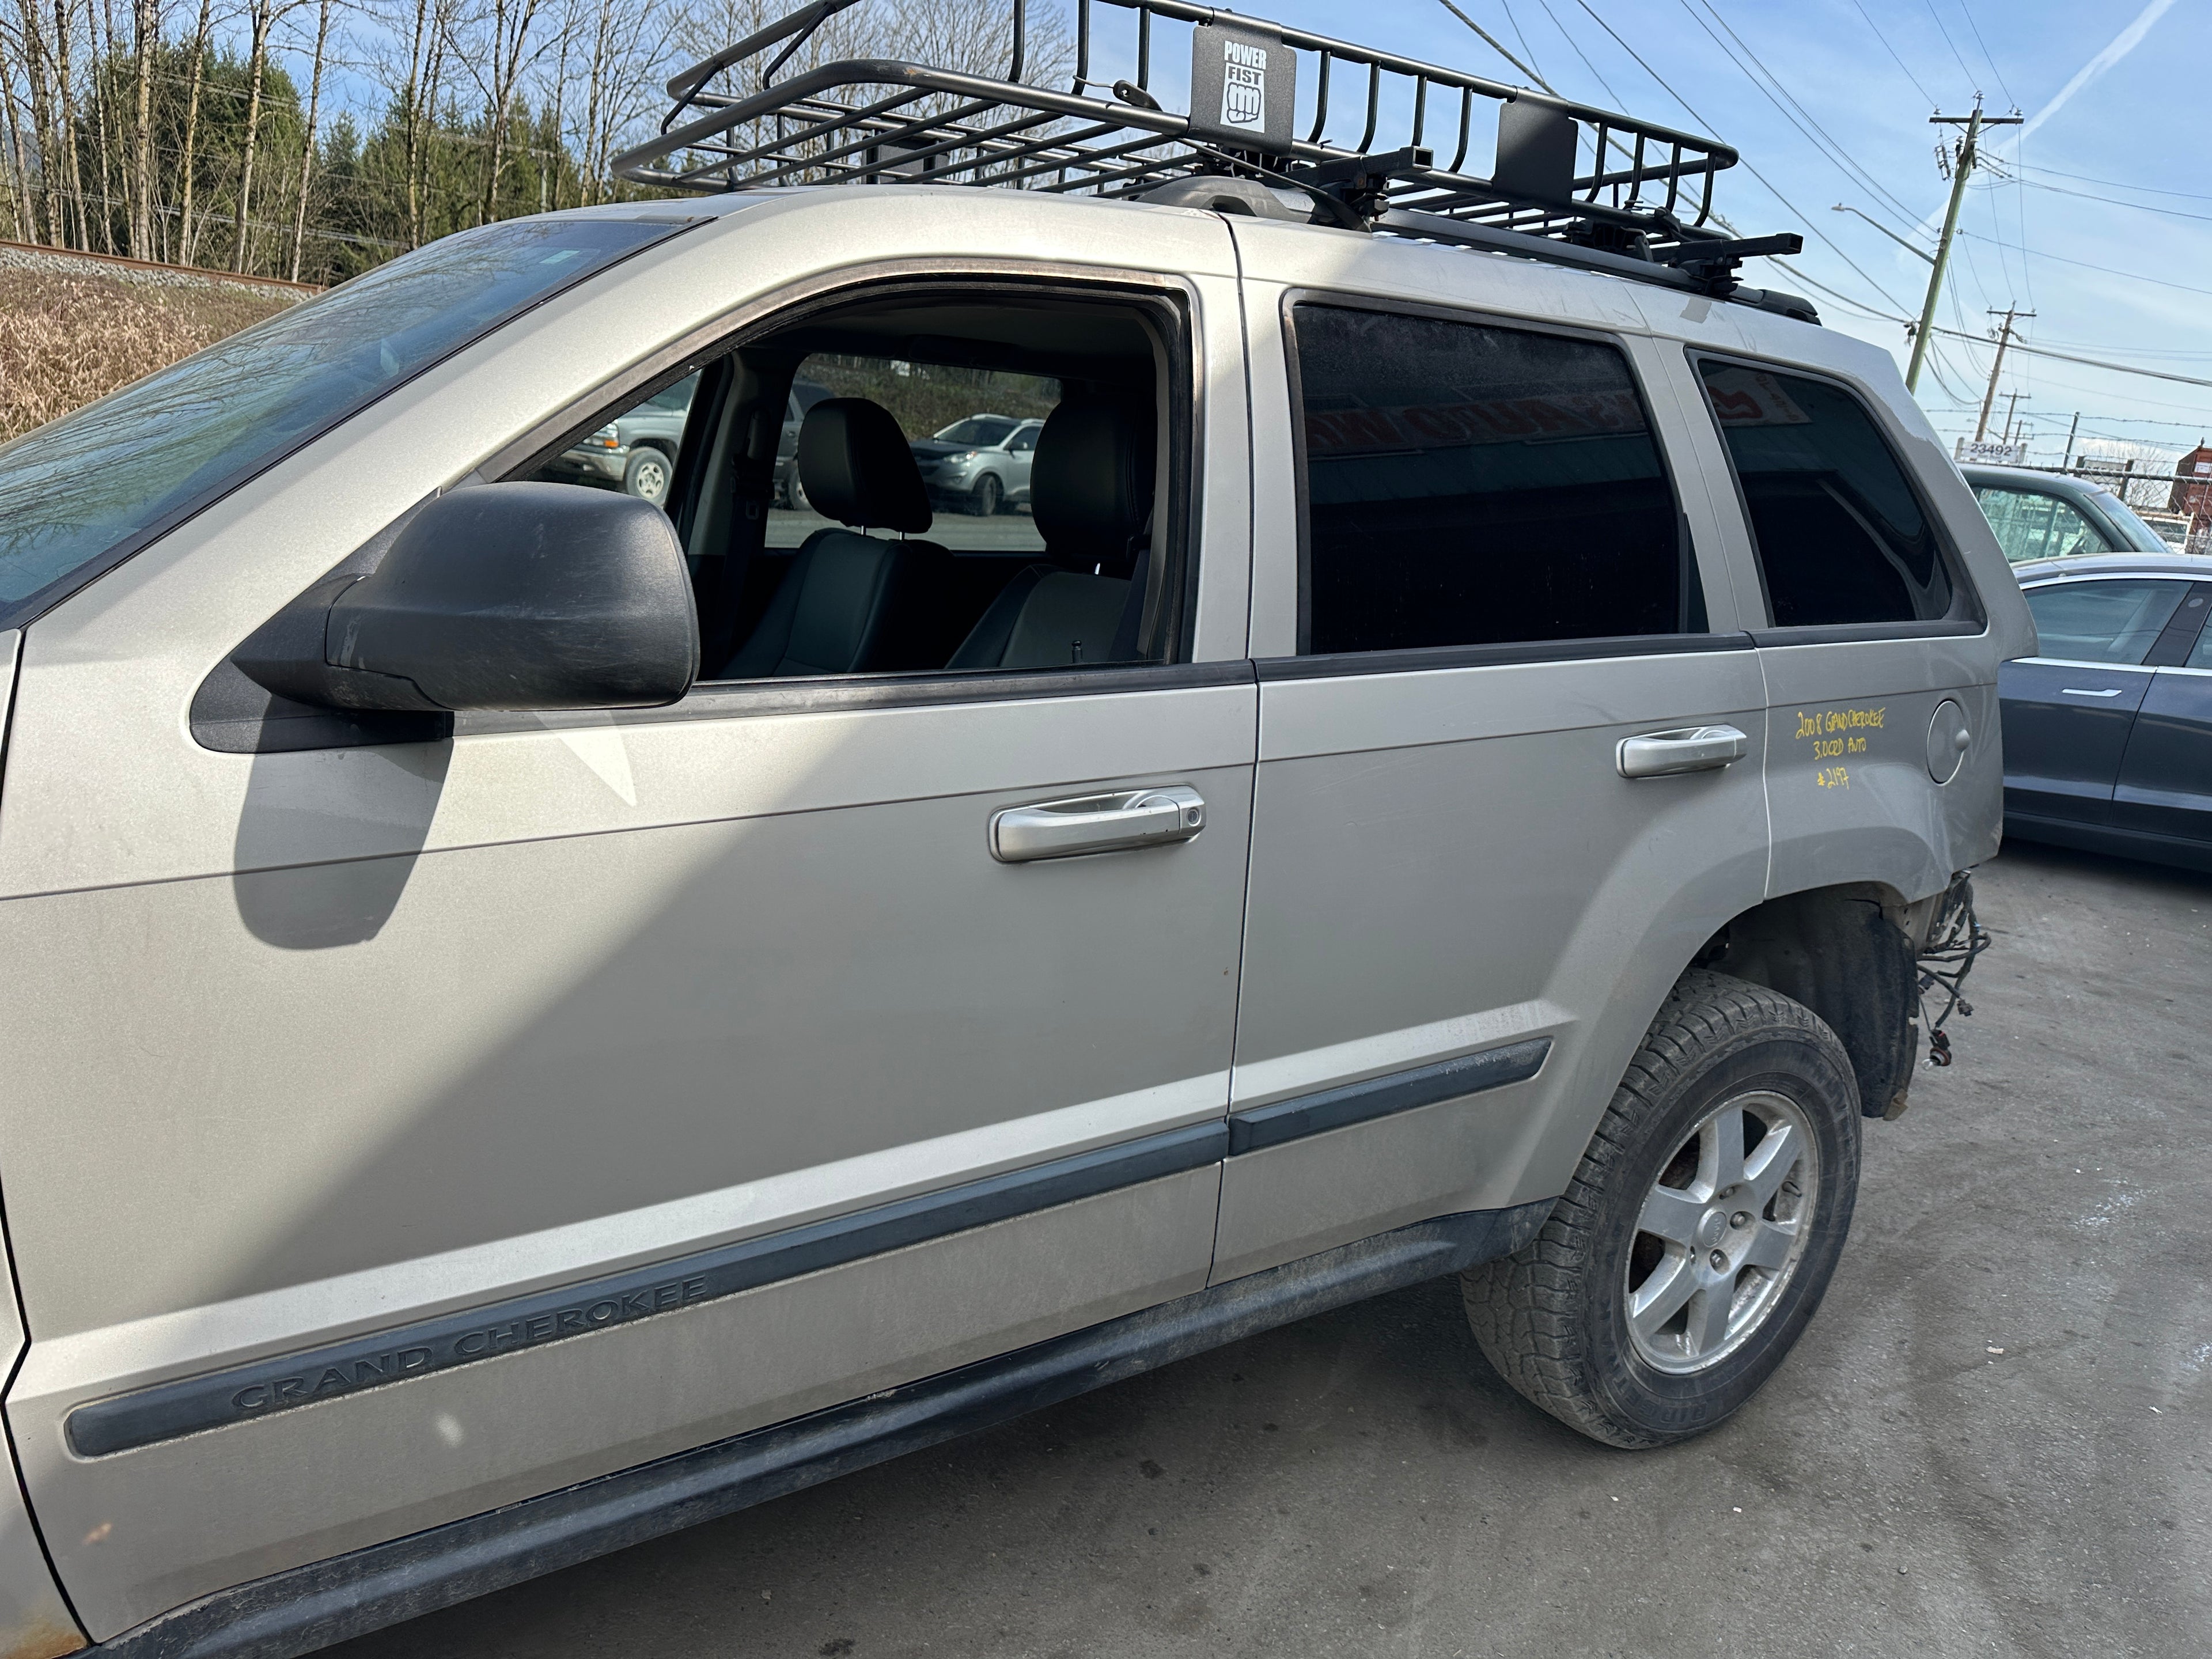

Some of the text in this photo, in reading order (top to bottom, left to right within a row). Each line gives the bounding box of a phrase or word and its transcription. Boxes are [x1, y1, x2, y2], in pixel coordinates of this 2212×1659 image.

[1224, 40, 1267, 70] POWER
[1228, 66, 1262, 85] FIST
[1970, 443, 2012, 456] 23492
[1795, 711, 1823, 739] 2008
[231, 1274, 706, 1409] GRAND CHEROKEE
